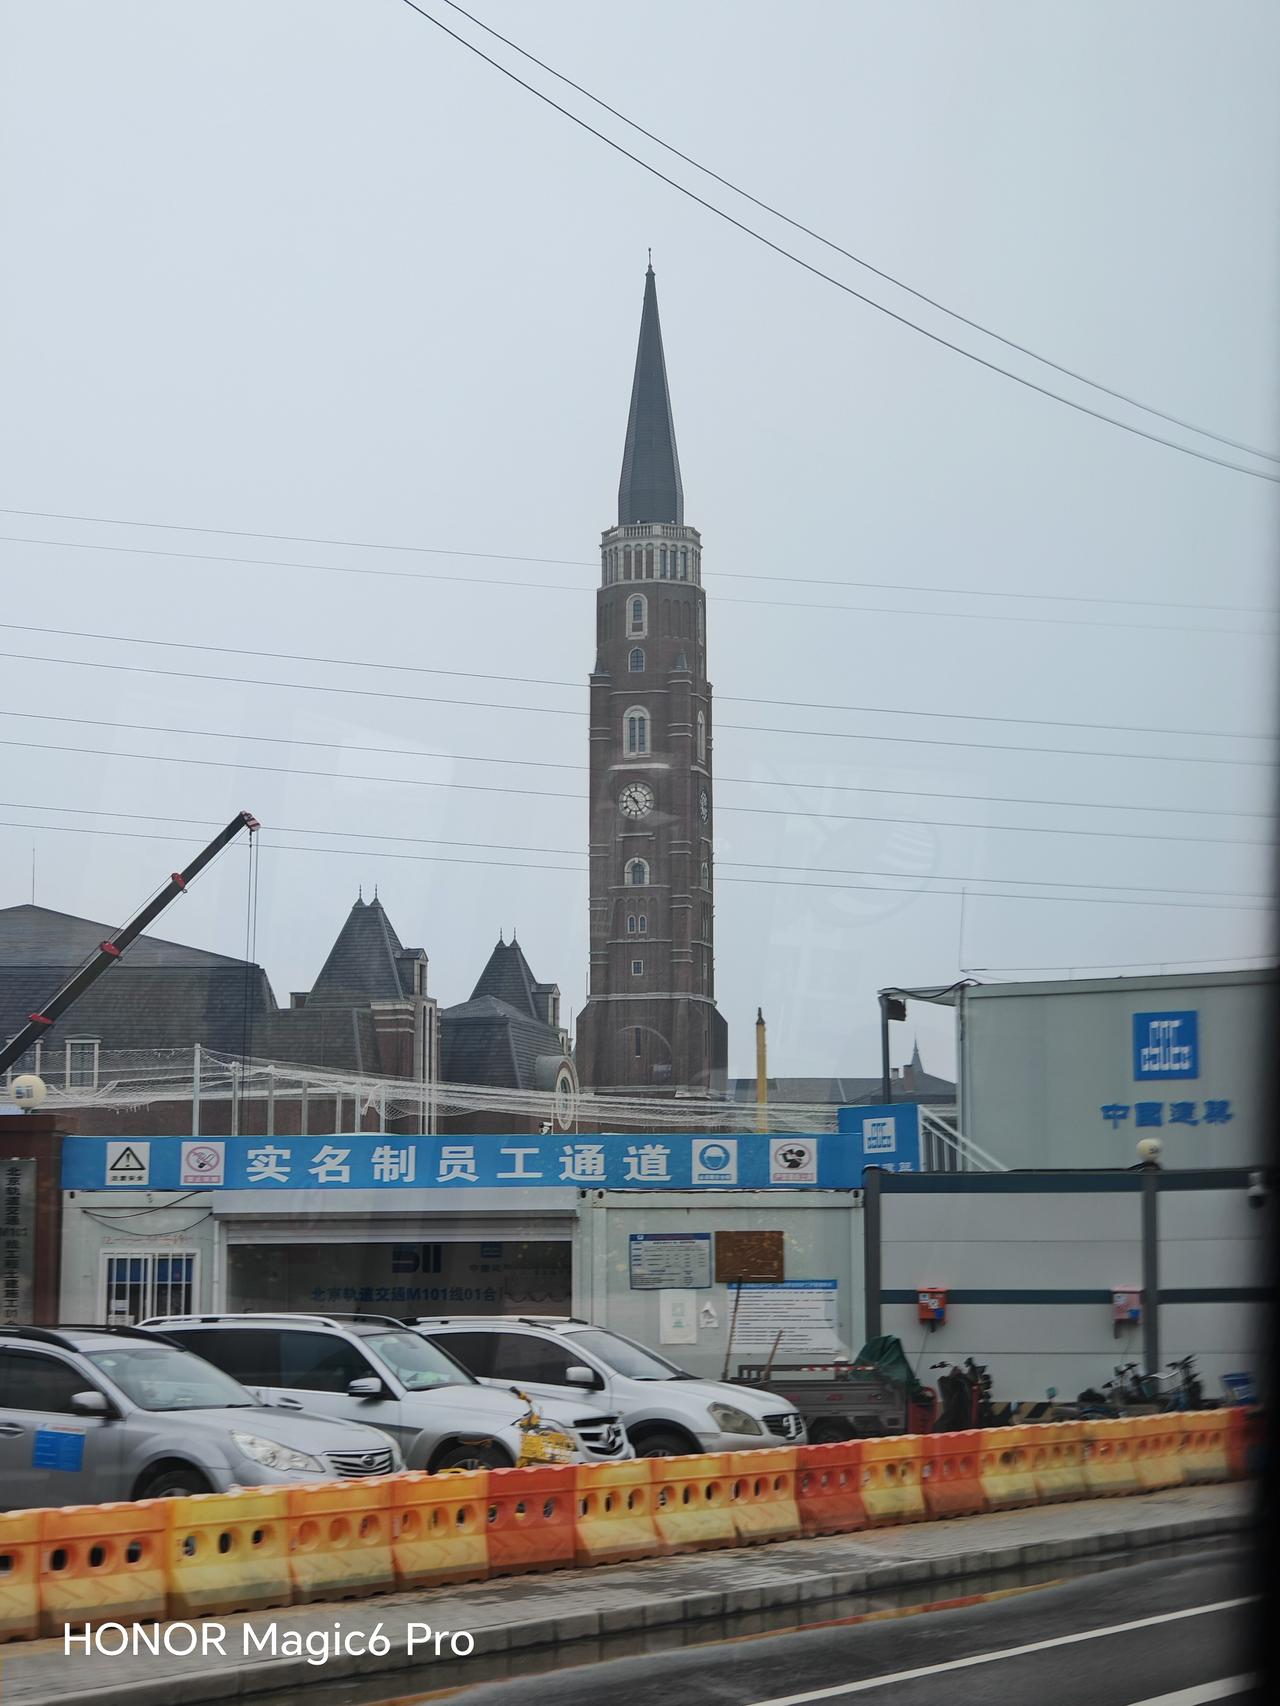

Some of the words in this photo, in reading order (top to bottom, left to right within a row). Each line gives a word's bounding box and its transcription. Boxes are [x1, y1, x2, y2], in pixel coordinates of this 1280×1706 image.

[246, 1143, 672, 1185] 实名制员工通道
